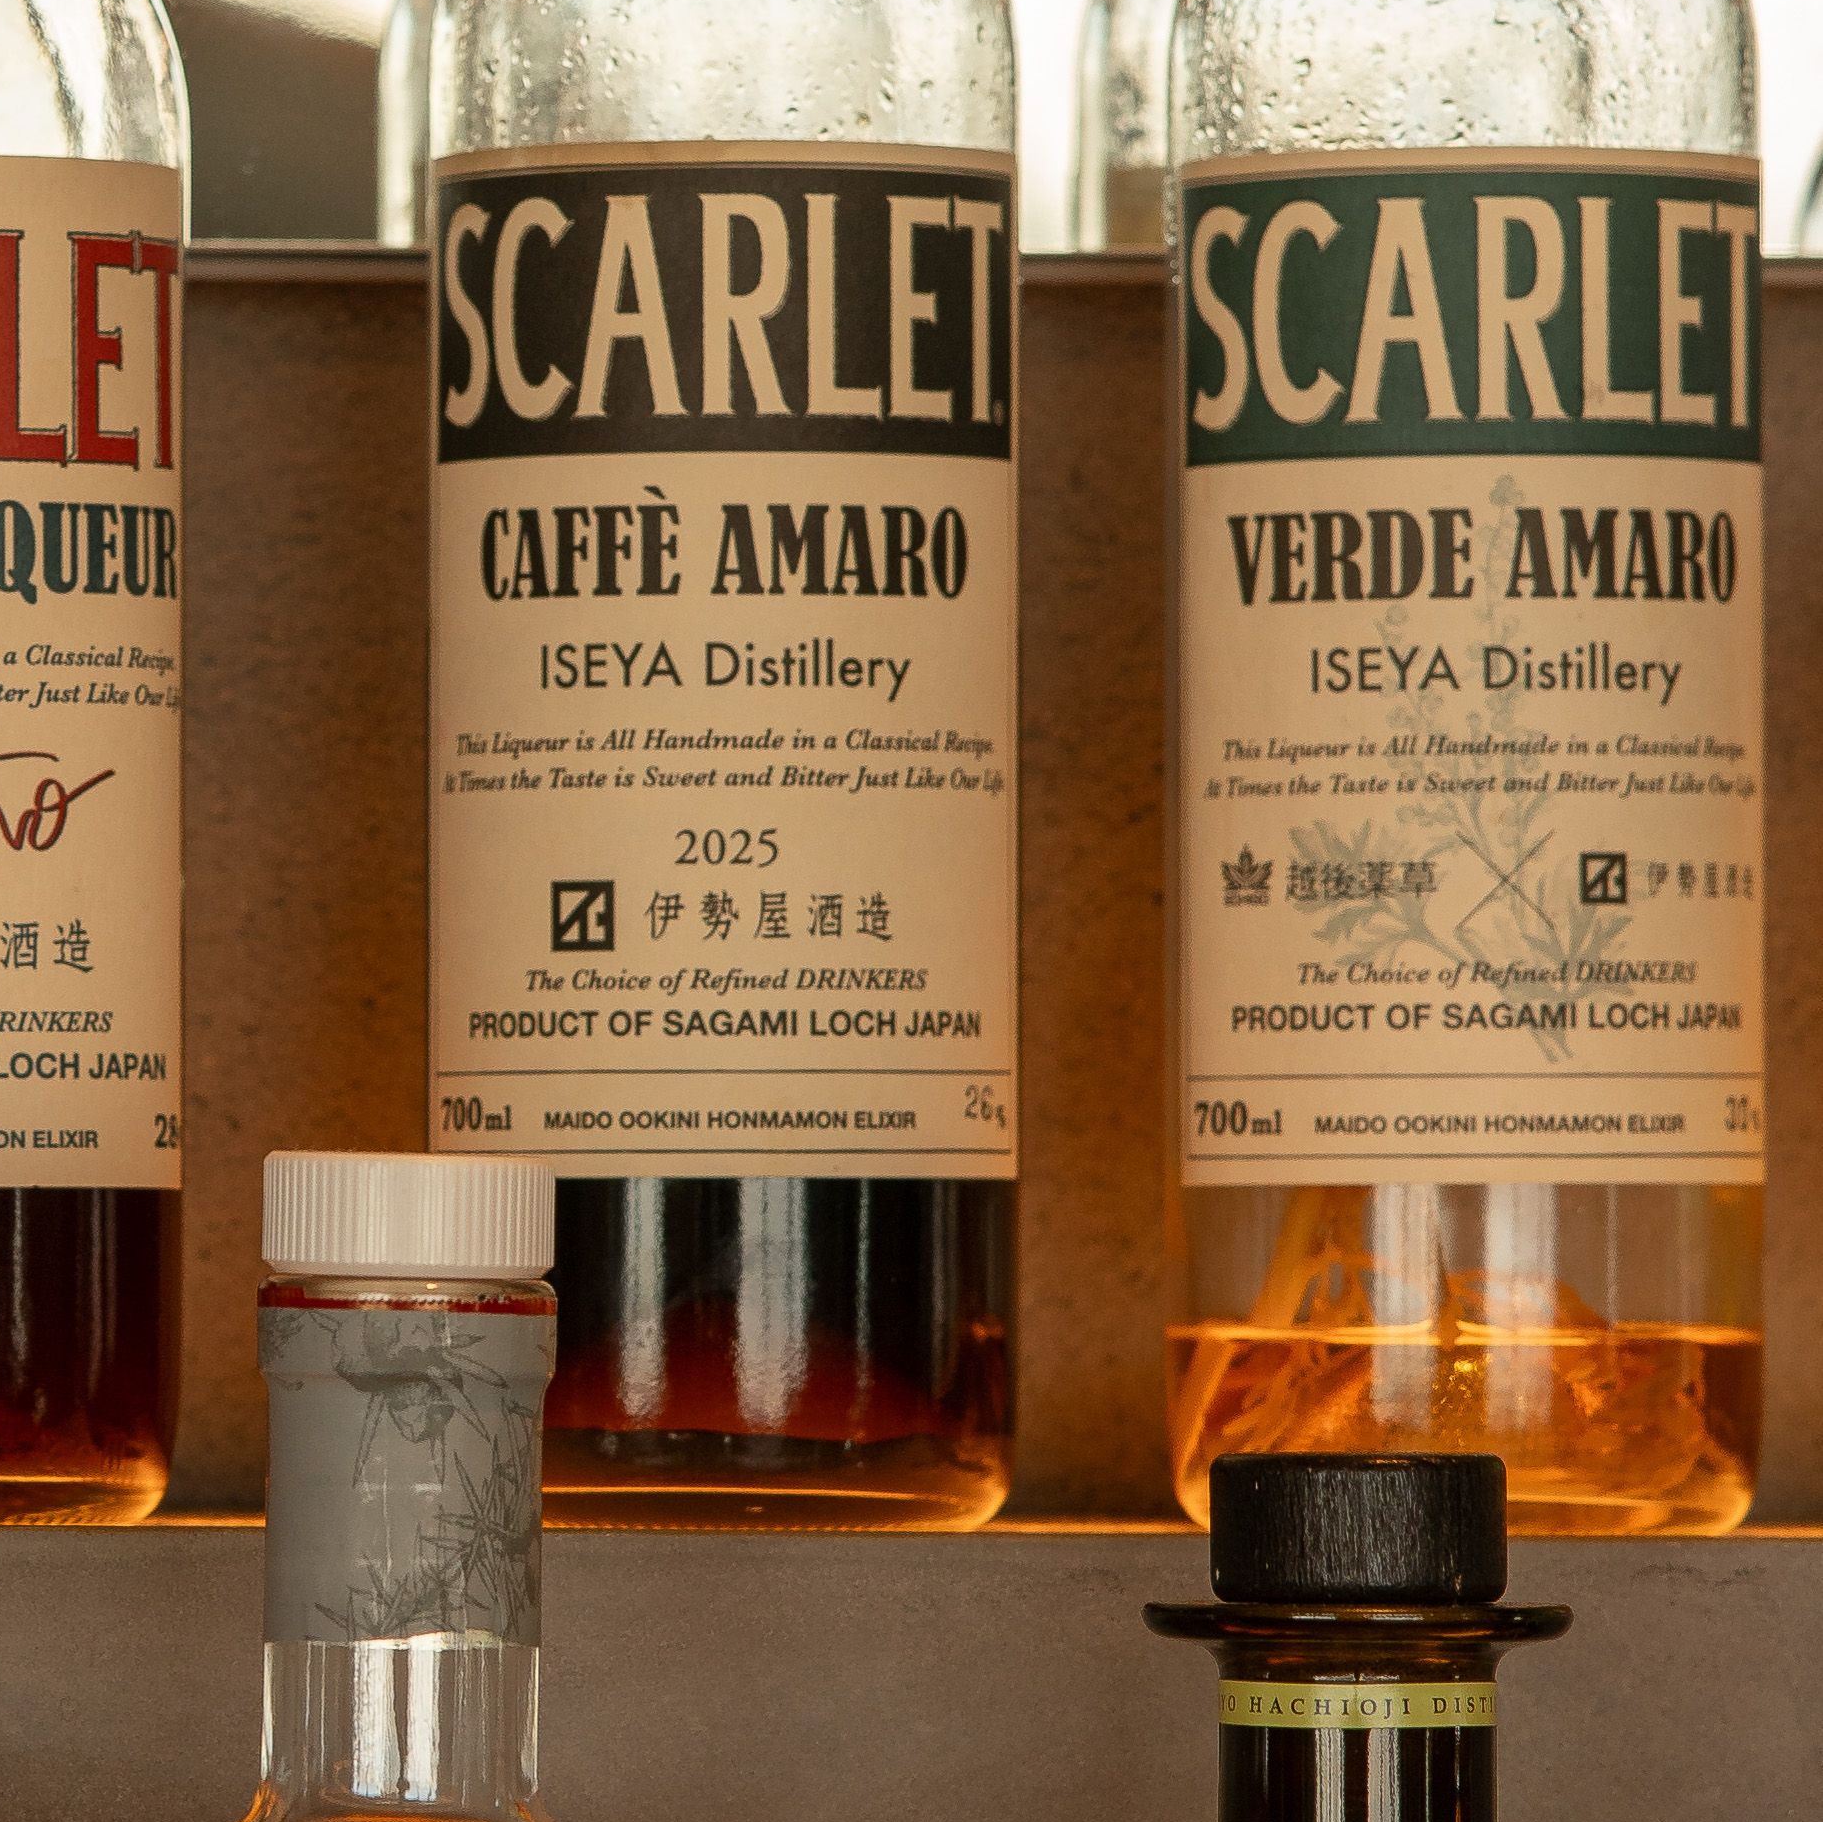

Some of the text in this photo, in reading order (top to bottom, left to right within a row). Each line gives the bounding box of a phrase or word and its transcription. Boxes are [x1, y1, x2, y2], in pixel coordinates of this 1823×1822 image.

[444, 192, 1004, 428] SCARLET
[1191, 194, 1757, 431] SCARLET
[480, 485, 967, 601] CAFFÈ AMARO
[1227, 508, 1736, 606] VERDE AMARO
[3, 650, 17, 666] a
[25, 644, 123, 669] Classical
[539, 638, 910, 702] ISEYA Distillery
[1310, 643, 1681, 707] ISEYA Distillery
[29, 681, 80, 708] Just
[87, 683, 129, 706] Like
[675, 828, 778, 868] 2025
[644, 889, 895, 943] 伊勢屋酒造
[469, 1009, 982, 1039] PRODUCT OF SAGAMI LOCH JAPAN
[89, 1053, 166, 1081] JAPAN
[33, 1130, 98, 1149] ELIXIR
[1249, 1696, 1411, 1718] HACHIOJI
